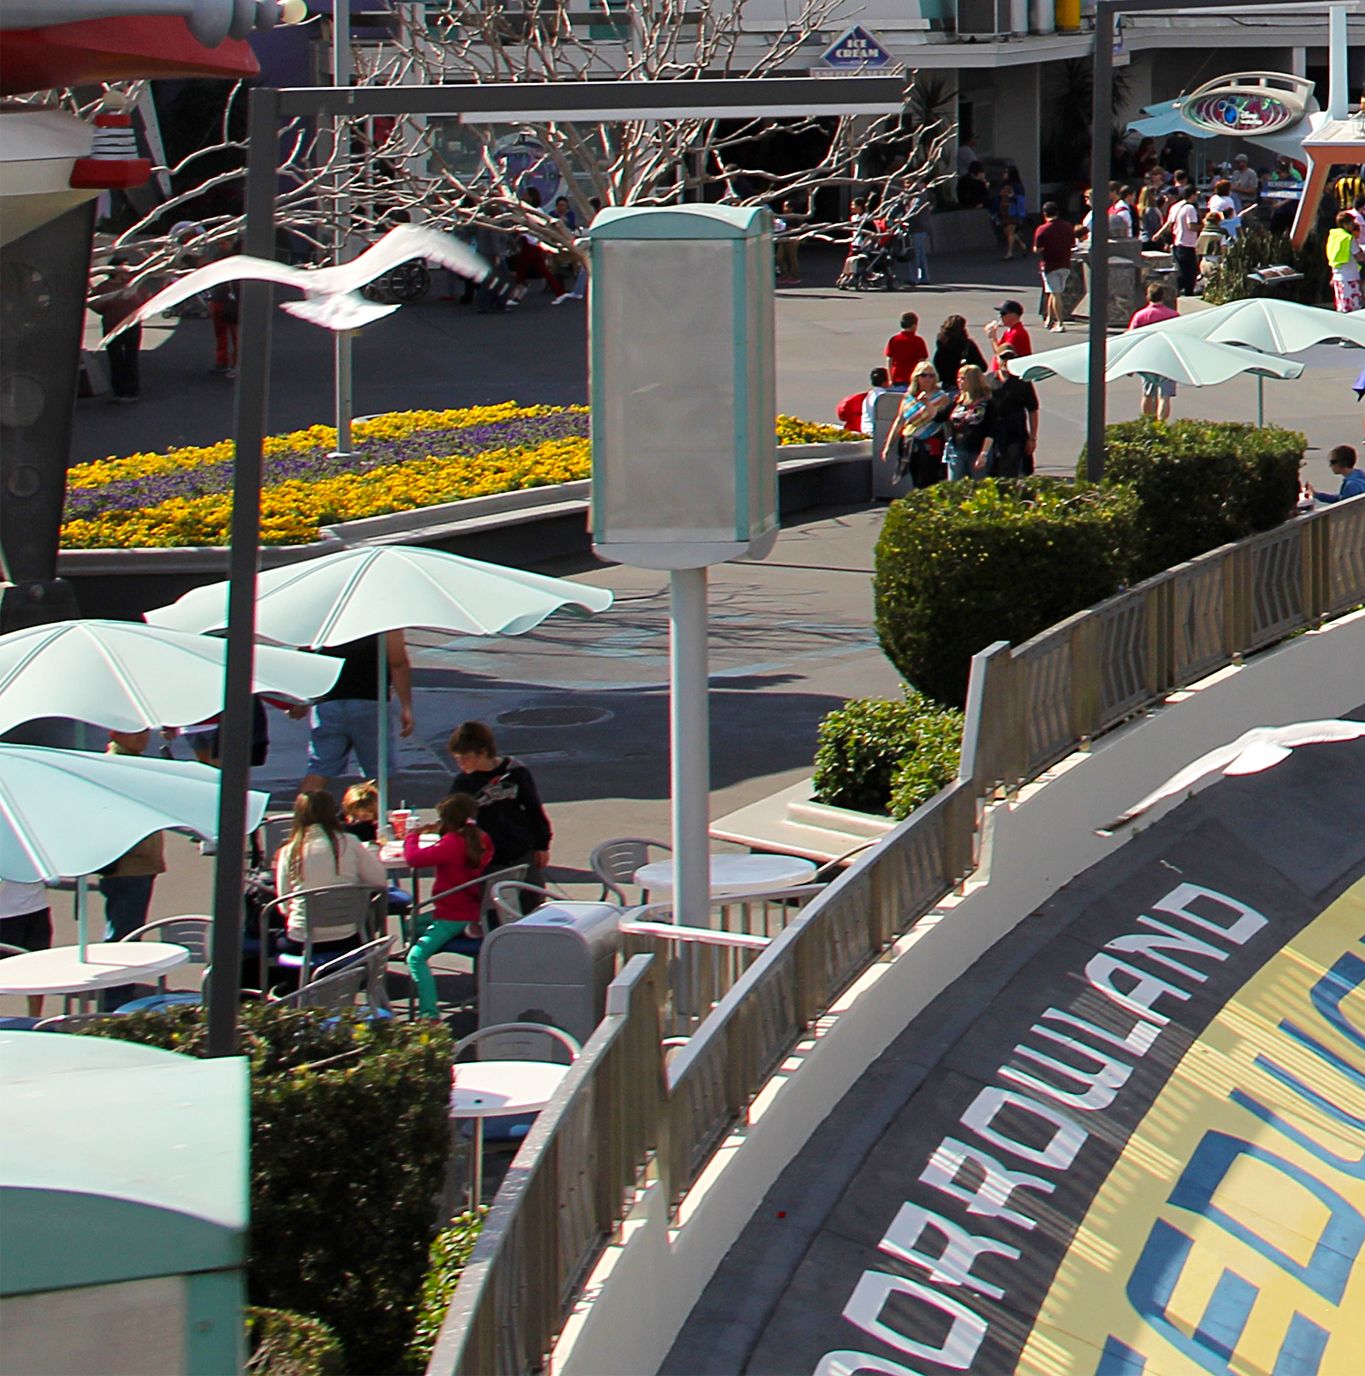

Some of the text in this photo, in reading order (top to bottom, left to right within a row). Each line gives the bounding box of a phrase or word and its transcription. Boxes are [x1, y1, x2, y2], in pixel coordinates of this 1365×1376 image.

[846, 39, 867, 48] ICE
[835, 48, 879, 58] CREAM
[814, 882, 1269, 1376] ORROWLAND
